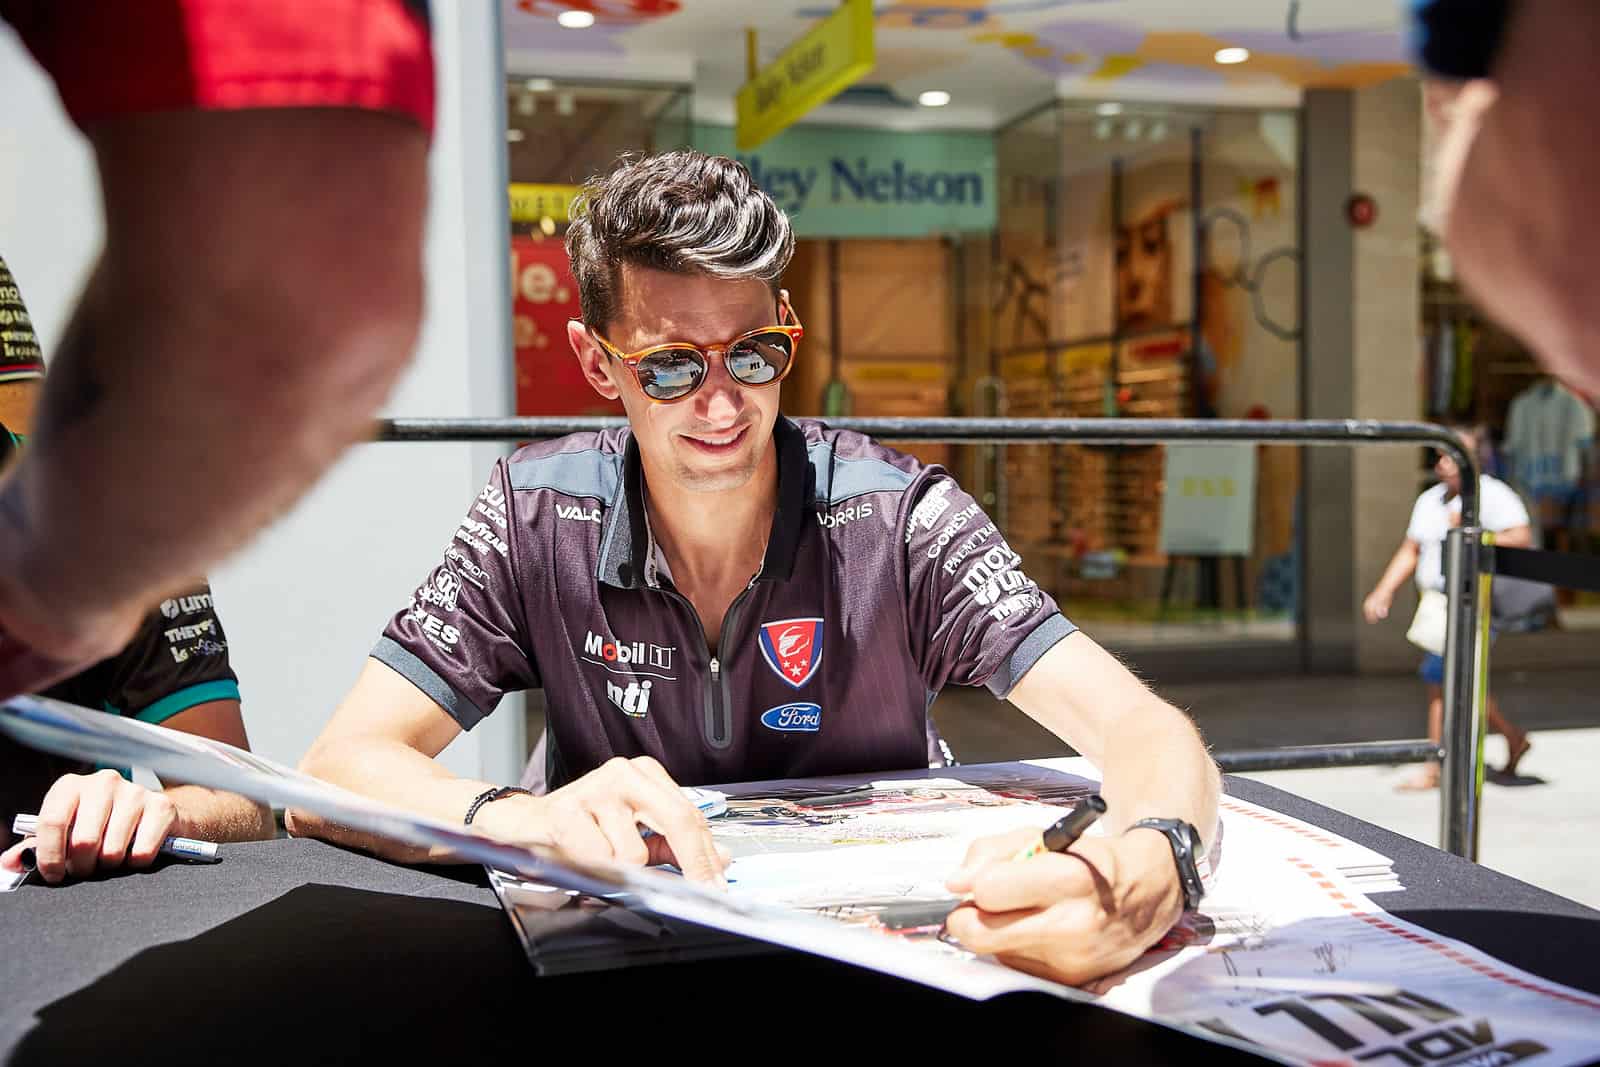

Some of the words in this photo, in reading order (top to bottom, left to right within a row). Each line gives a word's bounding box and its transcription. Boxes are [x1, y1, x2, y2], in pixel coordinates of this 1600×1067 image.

[829, 157, 984, 205] Nelson
[584, 630, 645, 665] Mobil
[778, 705, 820, 727] Ford
